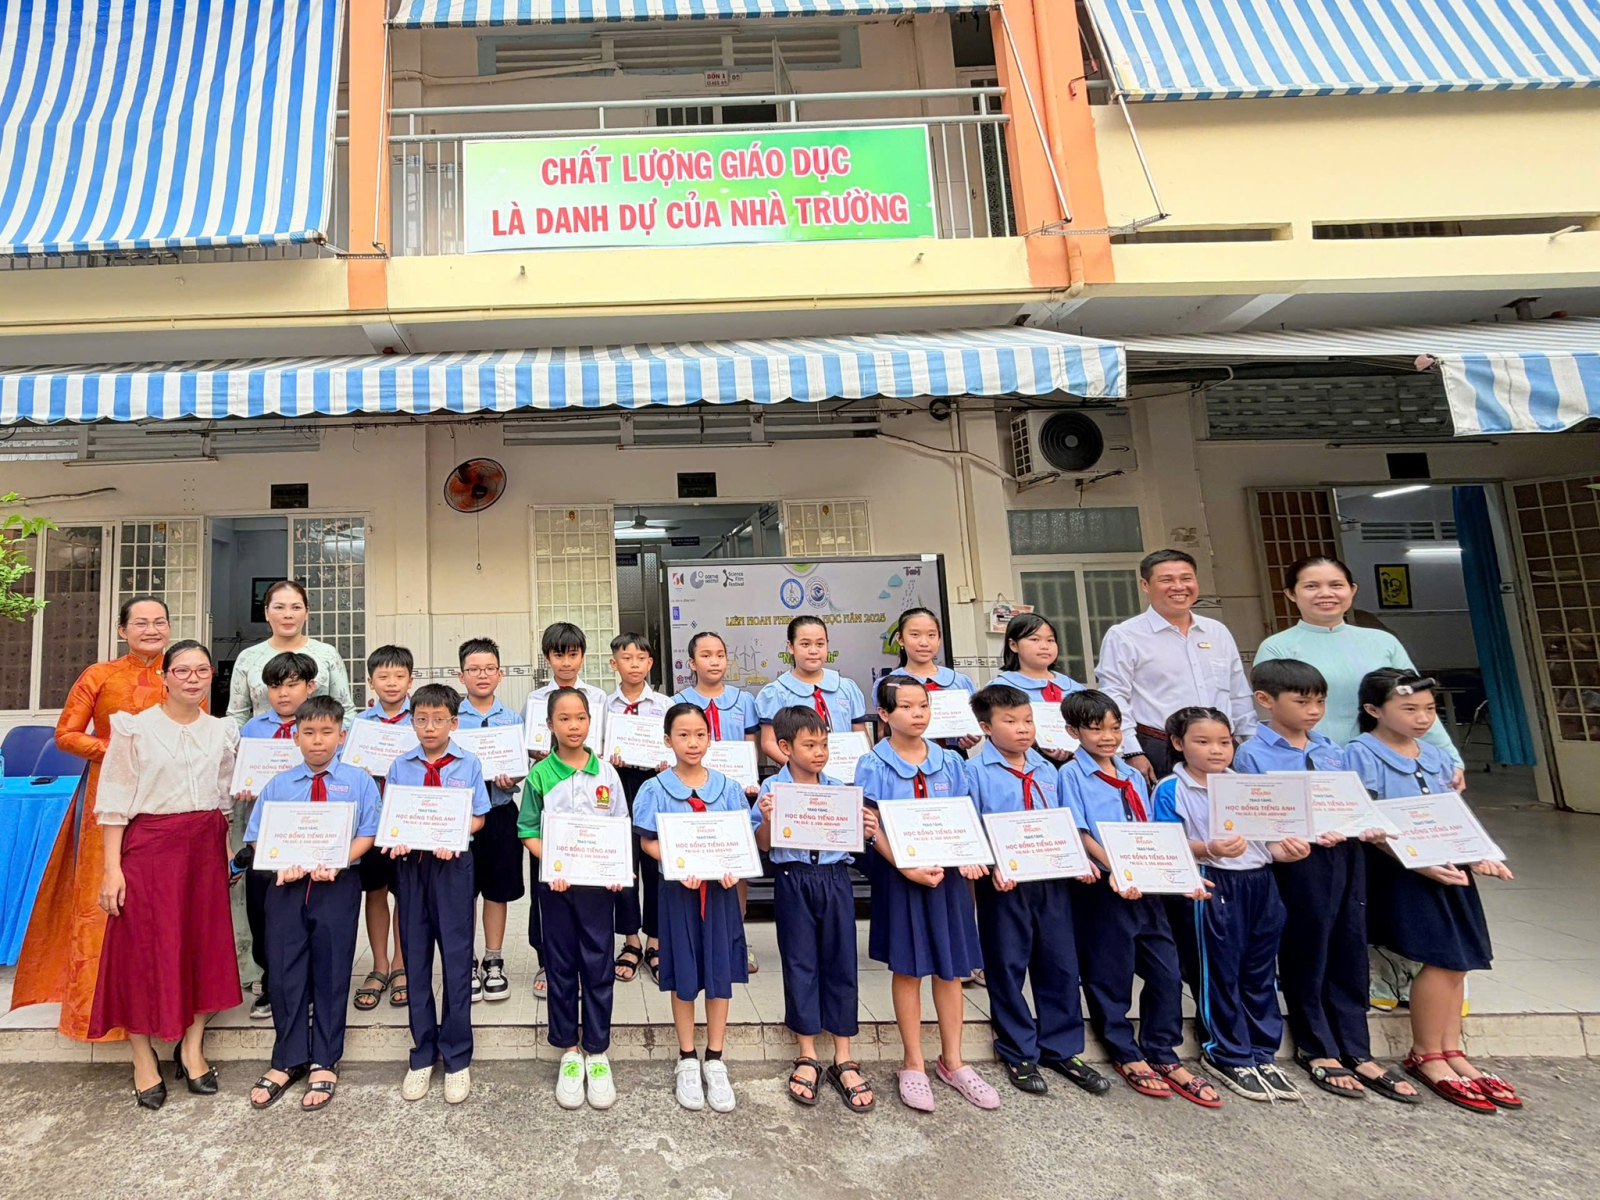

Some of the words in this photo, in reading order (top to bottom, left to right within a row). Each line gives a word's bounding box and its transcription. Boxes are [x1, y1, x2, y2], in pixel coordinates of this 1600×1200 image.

[541, 146, 612, 186] CHẤT
[622, 148, 712, 186] LƯỢNG
[720, 143, 784, 178] GIÁO
[793, 147, 850, 181] DỤC
[492, 201, 525, 236] LÀ
[536, 205, 608, 234] DANH
[619, 198, 657, 236] DỰ
[666, 191, 722, 229] CỦA
[730, 191, 786, 227] NHÀ
[795, 189, 908, 225] TRƯỜNG
[725, 615, 745, 626] LIÊN
[747, 616, 771, 626] HOAN
[844, 613, 862, 624] NĂM
[864, 612, 886, 623] 2025
[586, 846, 603, 854] TIẾNG
